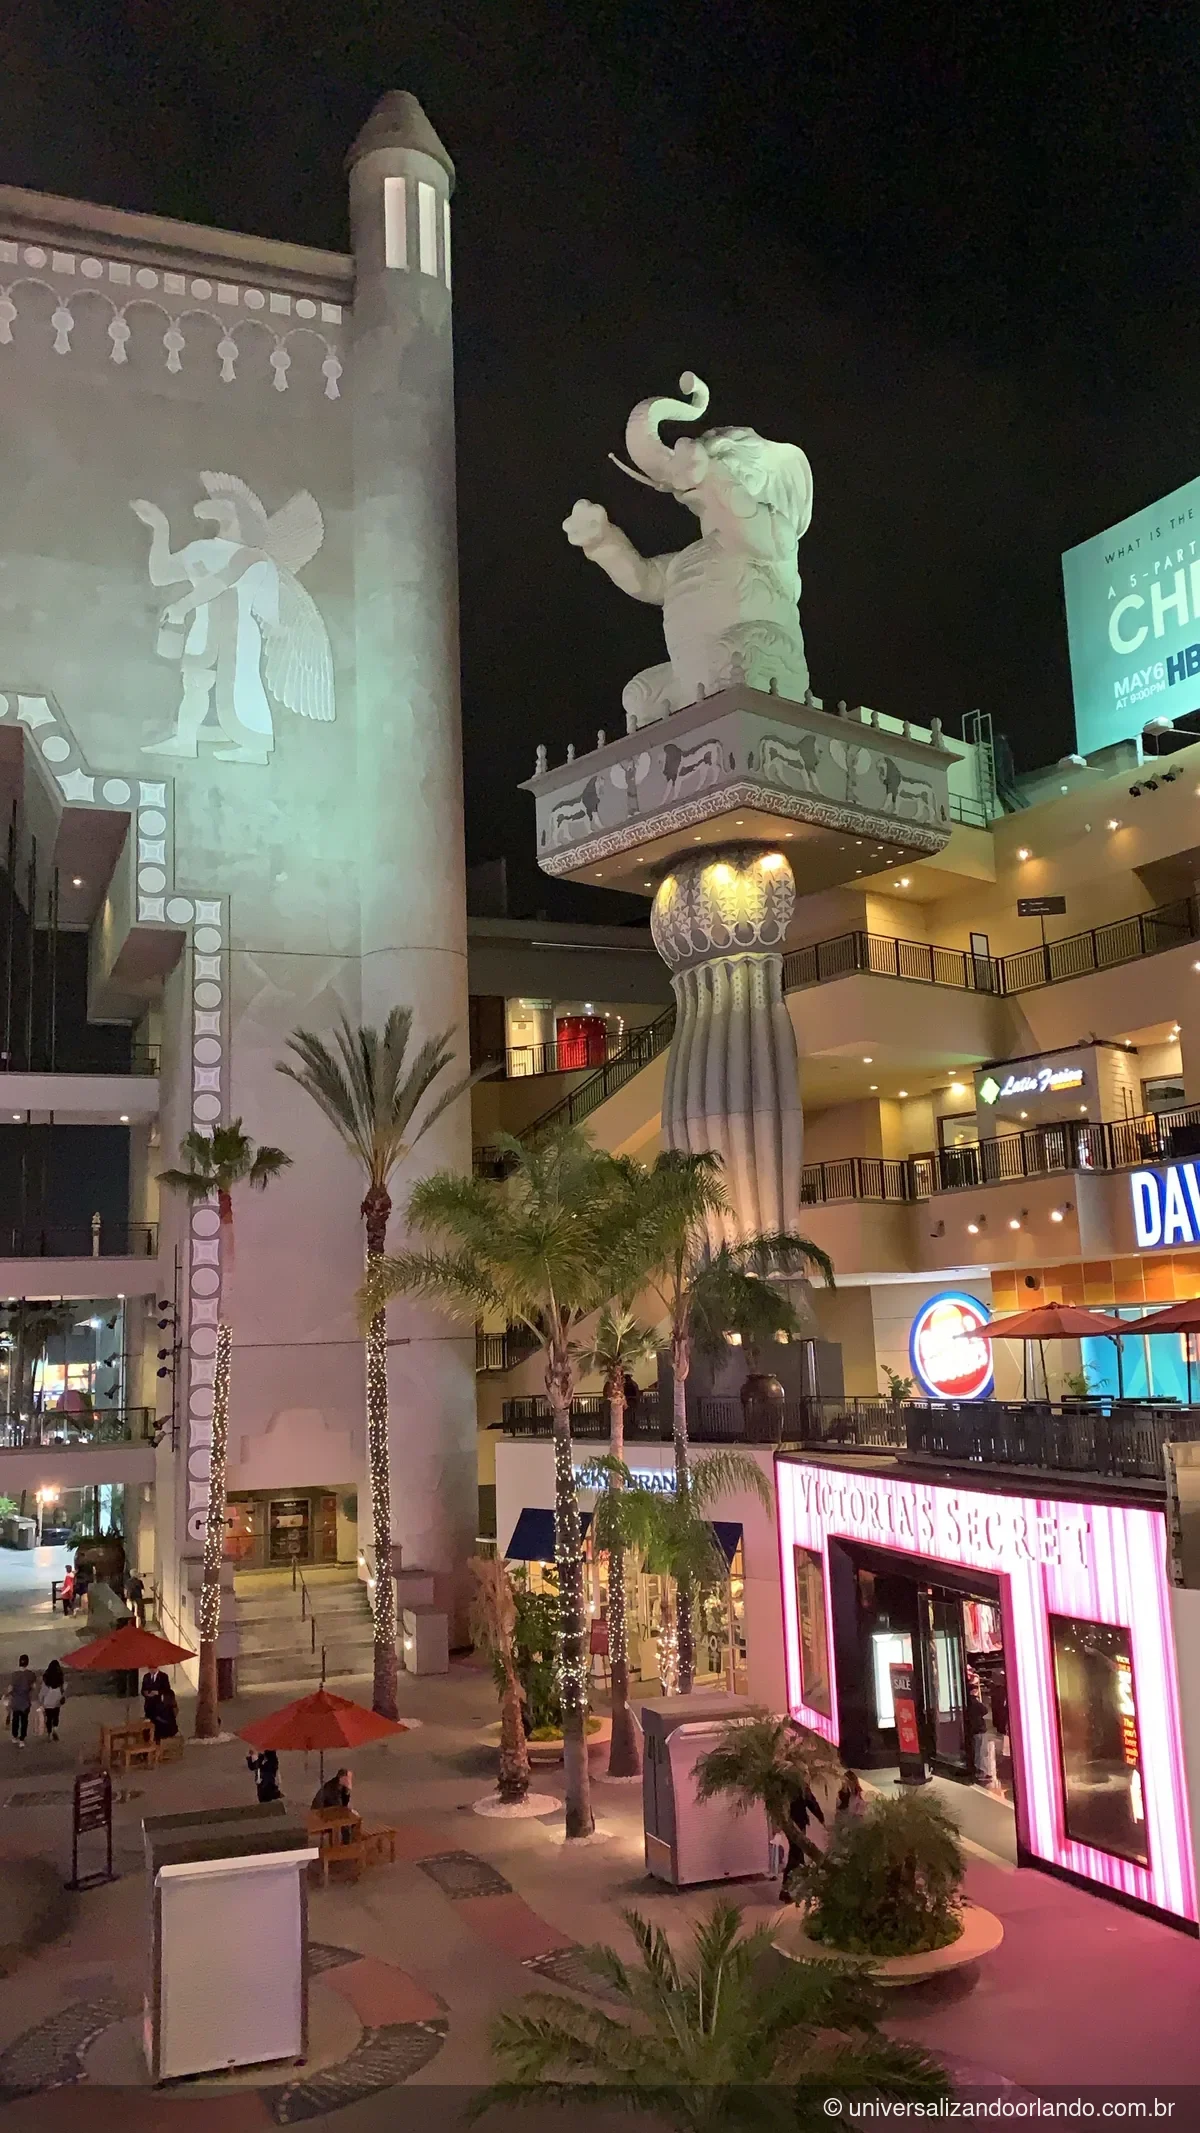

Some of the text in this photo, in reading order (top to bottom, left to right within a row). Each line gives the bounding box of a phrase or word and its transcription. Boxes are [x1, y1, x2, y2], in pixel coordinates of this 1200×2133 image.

[1105, 508, 1194, 564] WHAT IS THE
[1107, 541, 1196, 600] A 5-PART
[1114, 666, 1153, 699] MAY
[1115, 696, 1128, 711] AT
[1000, 1075, 1038, 1096] Latin
[799, 1472, 1091, 1568] VICTORIA'S SECRET
[894, 1679, 912, 1691] SALE
